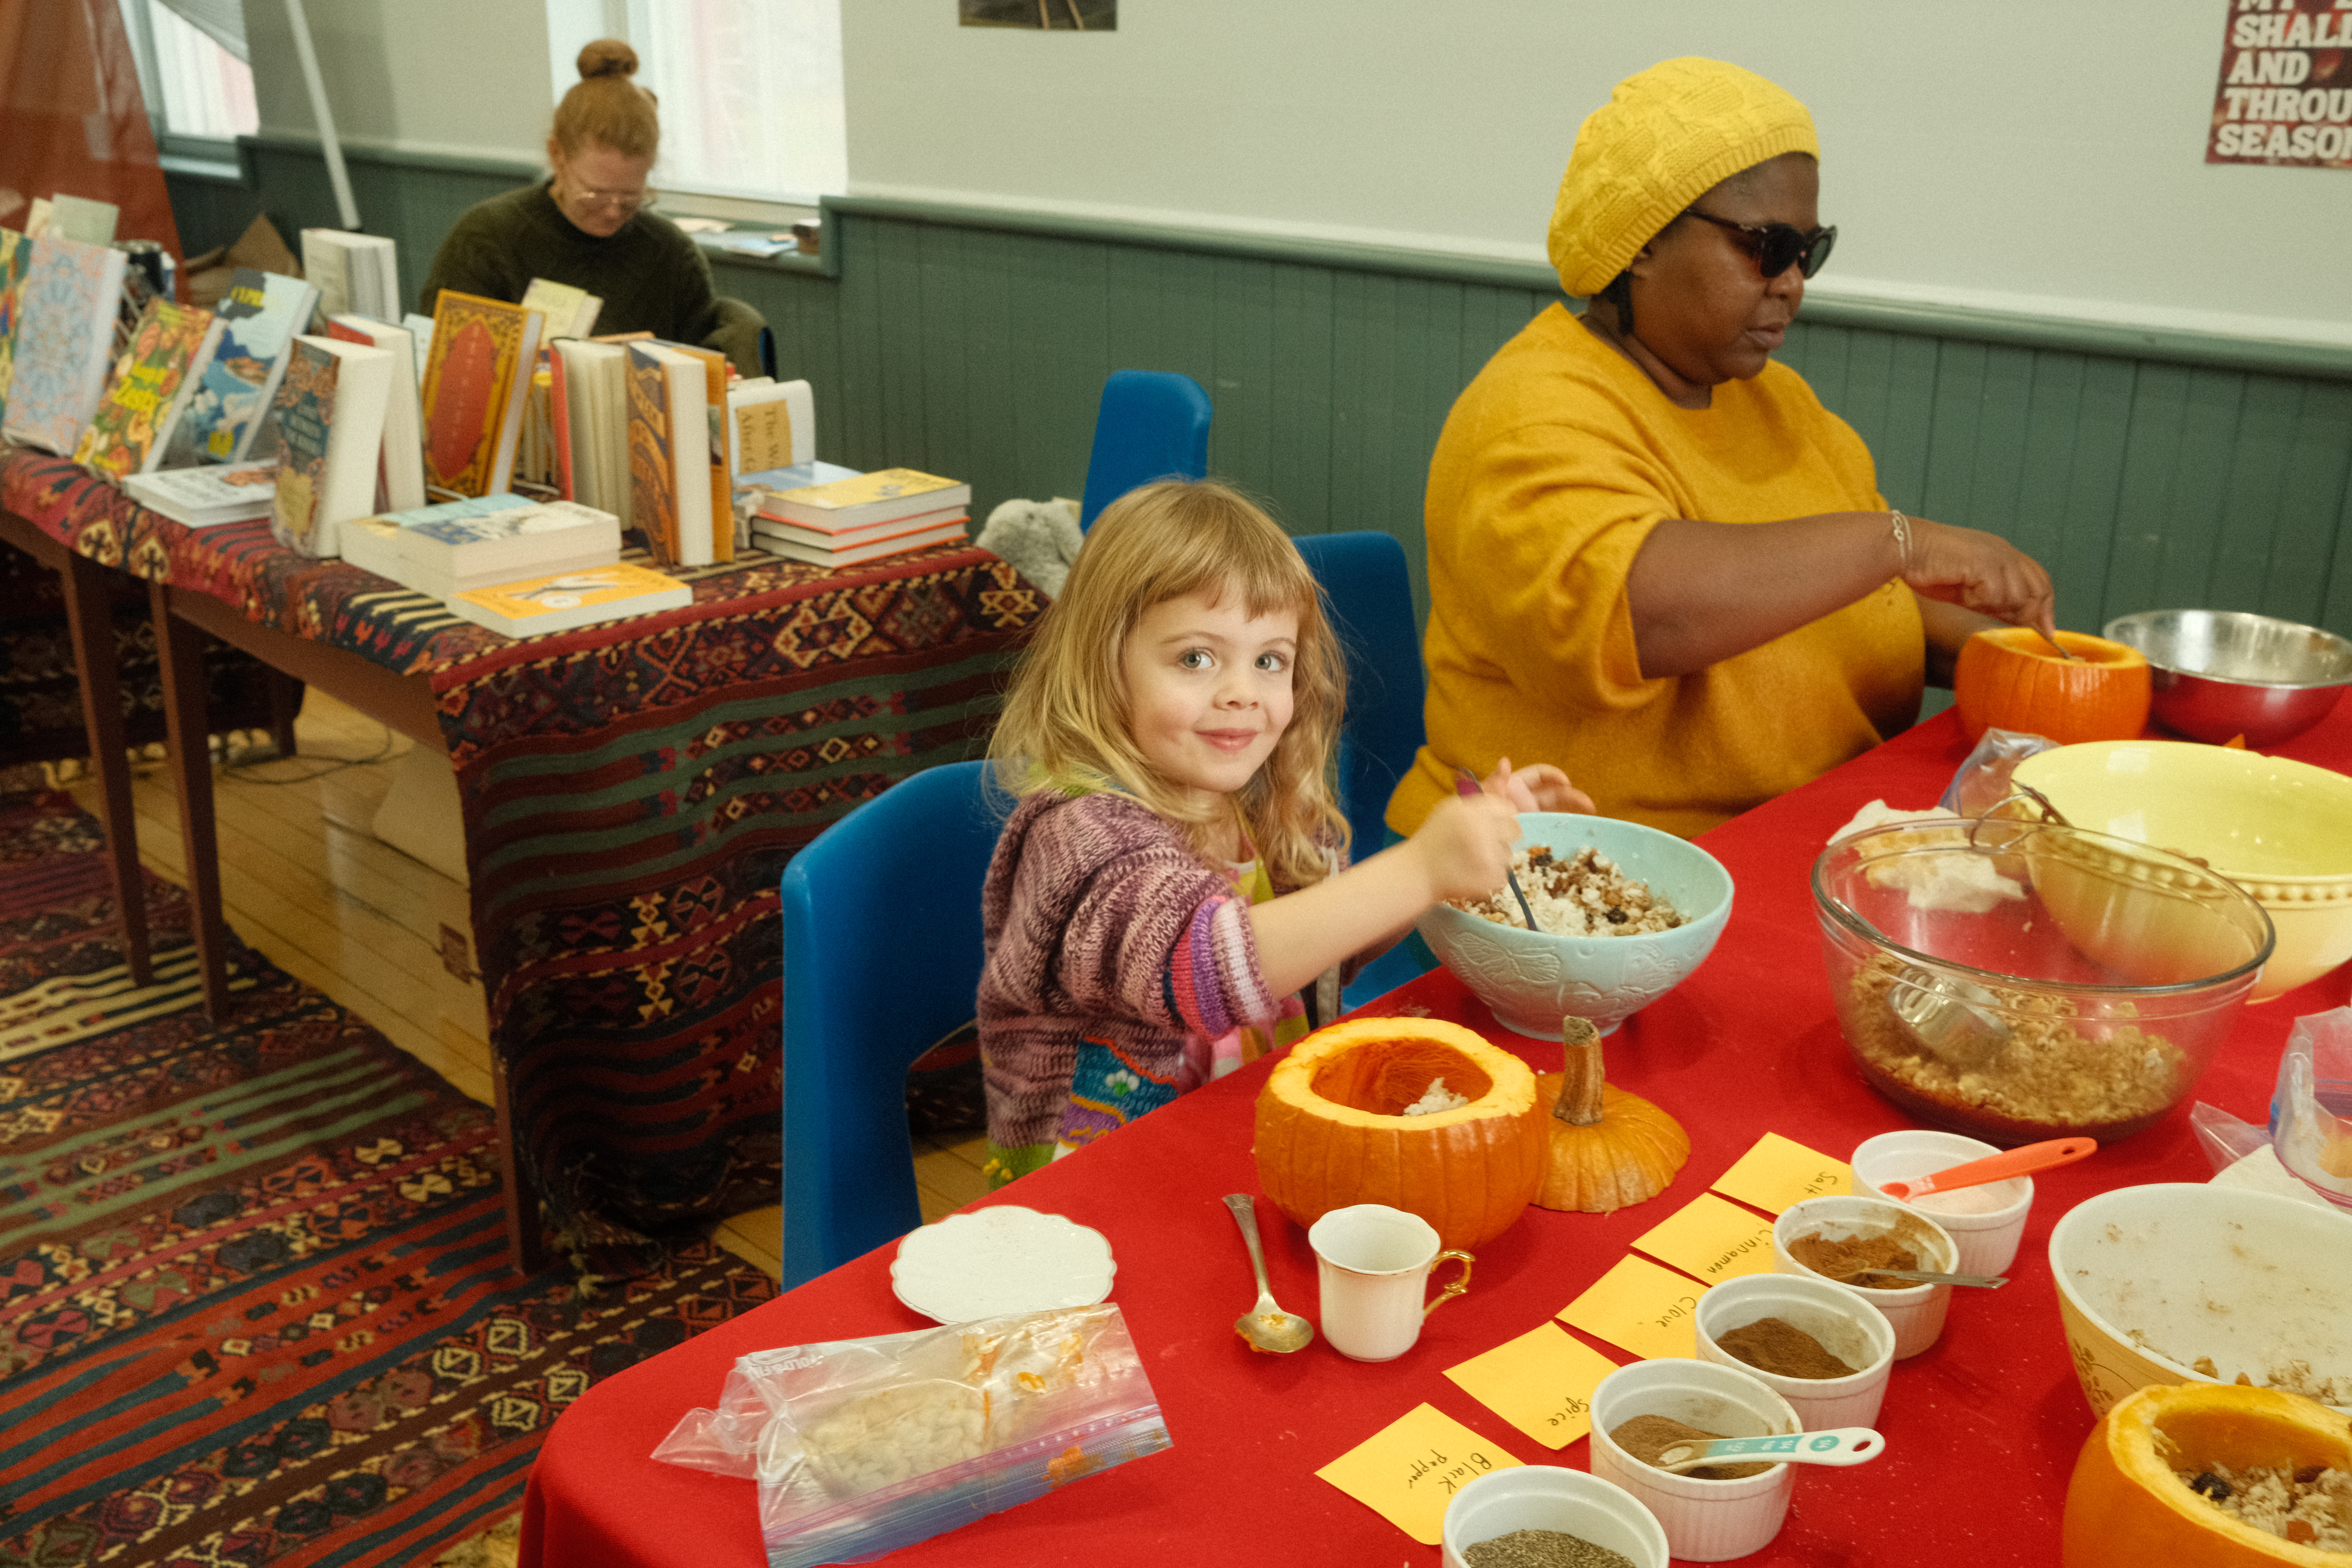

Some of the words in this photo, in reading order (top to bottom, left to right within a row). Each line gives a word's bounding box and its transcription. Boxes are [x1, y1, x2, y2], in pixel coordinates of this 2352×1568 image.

[2226, 51, 2310, 85] AND
[1803, 1171, 1838, 1194] Salt
[1655, 1297, 1697, 1327] Clove
[1408, 1449, 1447, 1489] pepper
